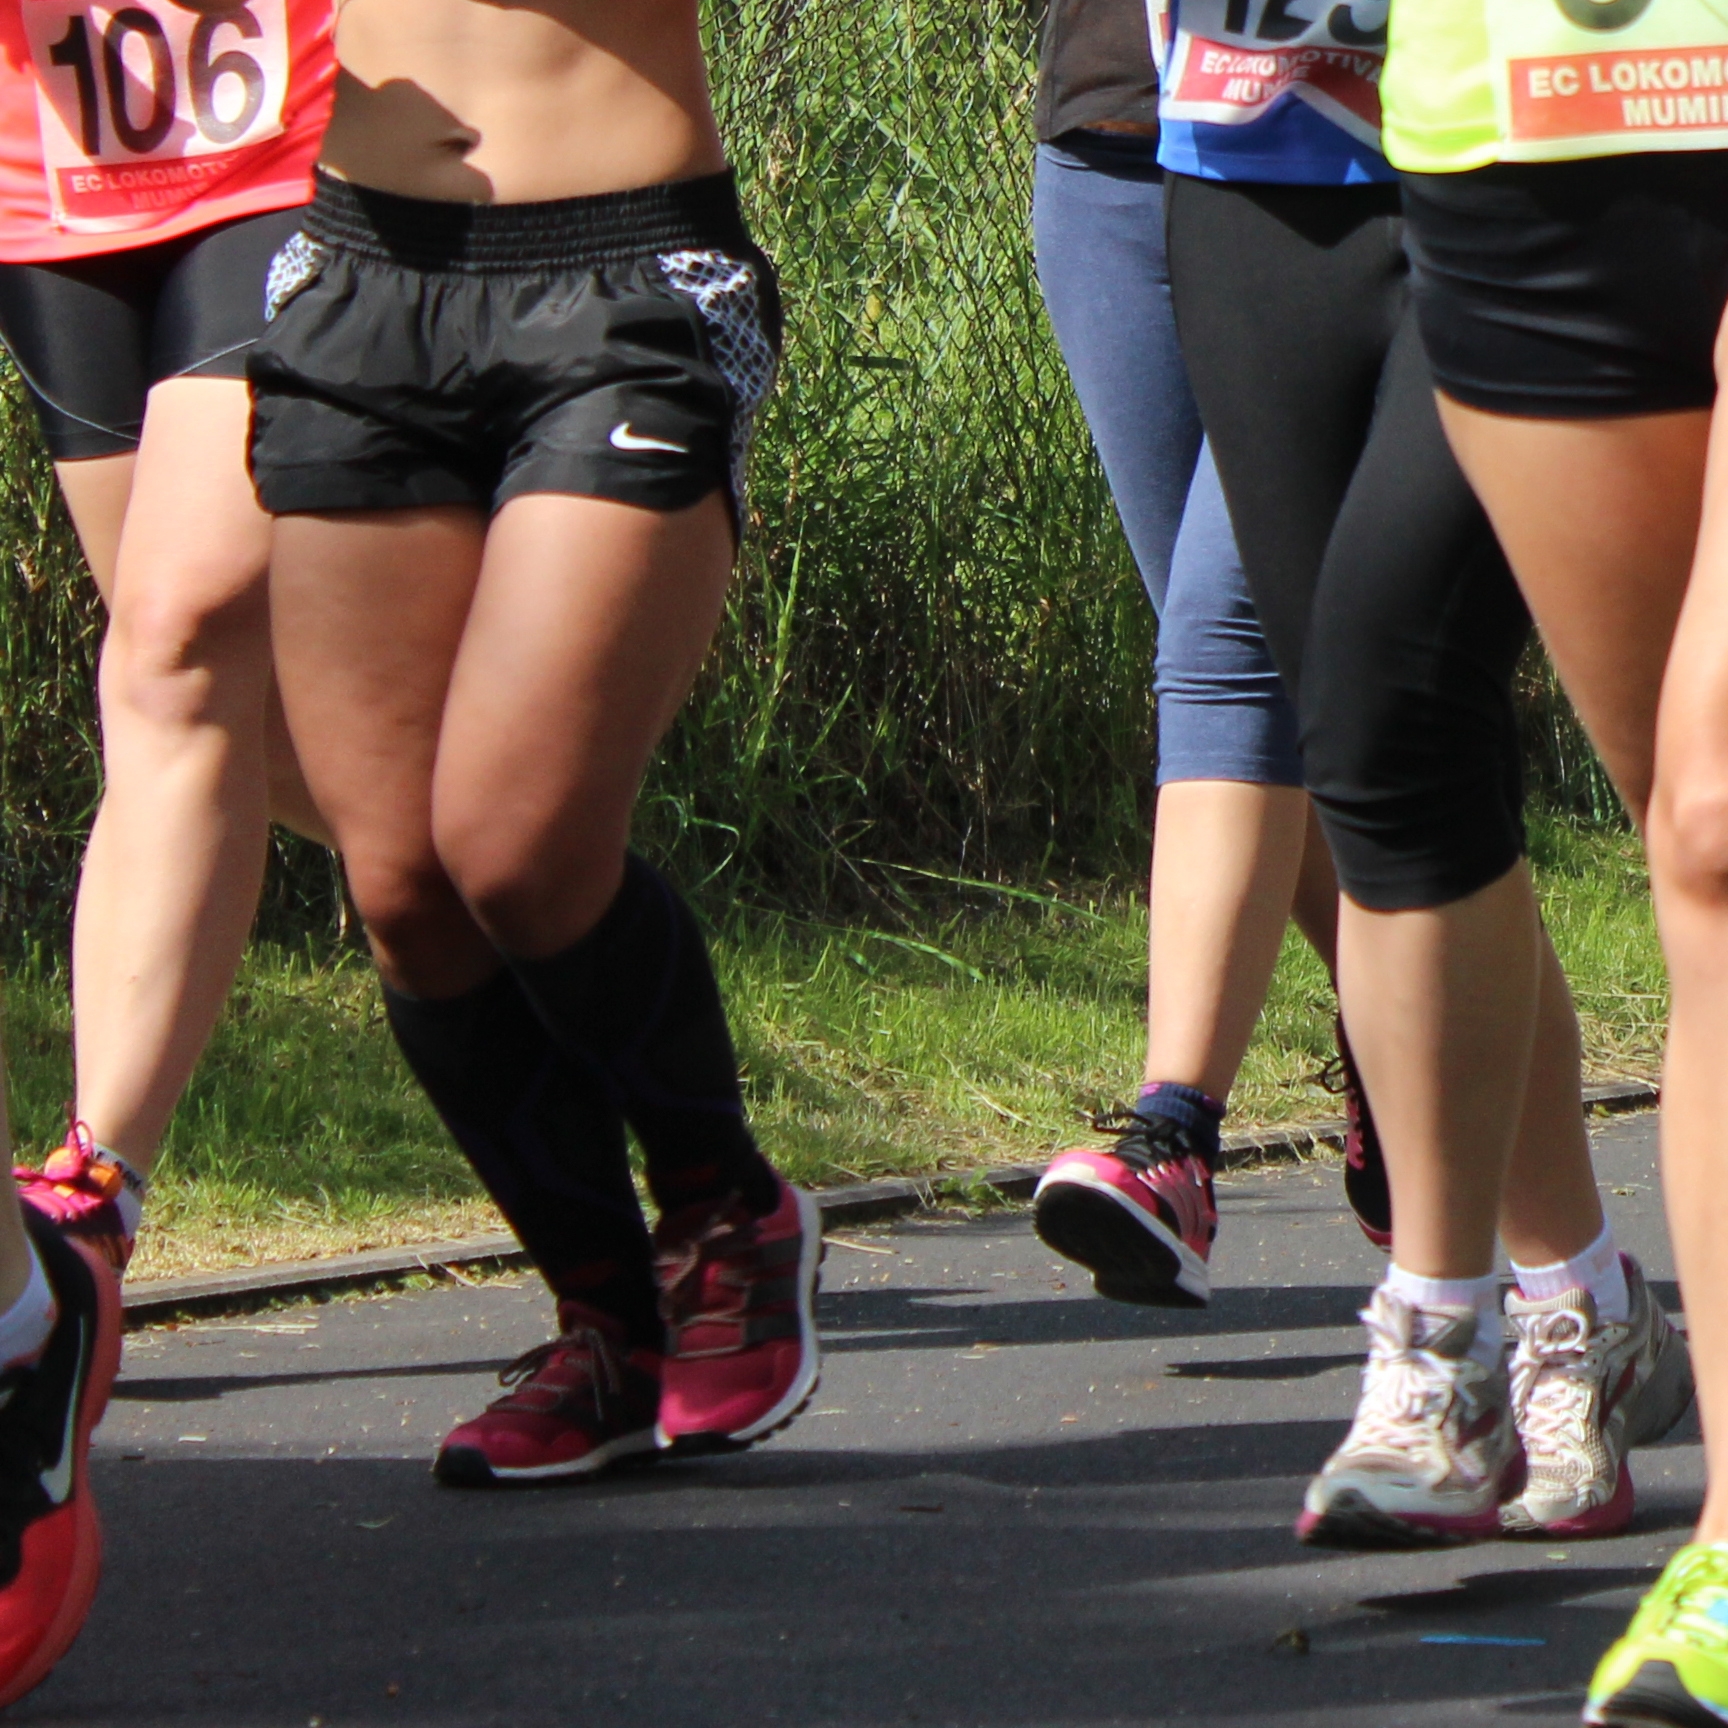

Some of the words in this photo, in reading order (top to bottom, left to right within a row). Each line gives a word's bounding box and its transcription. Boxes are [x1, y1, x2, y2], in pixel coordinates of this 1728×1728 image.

[49, 5, 266, 158] 106
[1528, 65, 1580, 100] EC
[71, 173, 103, 195] EC
